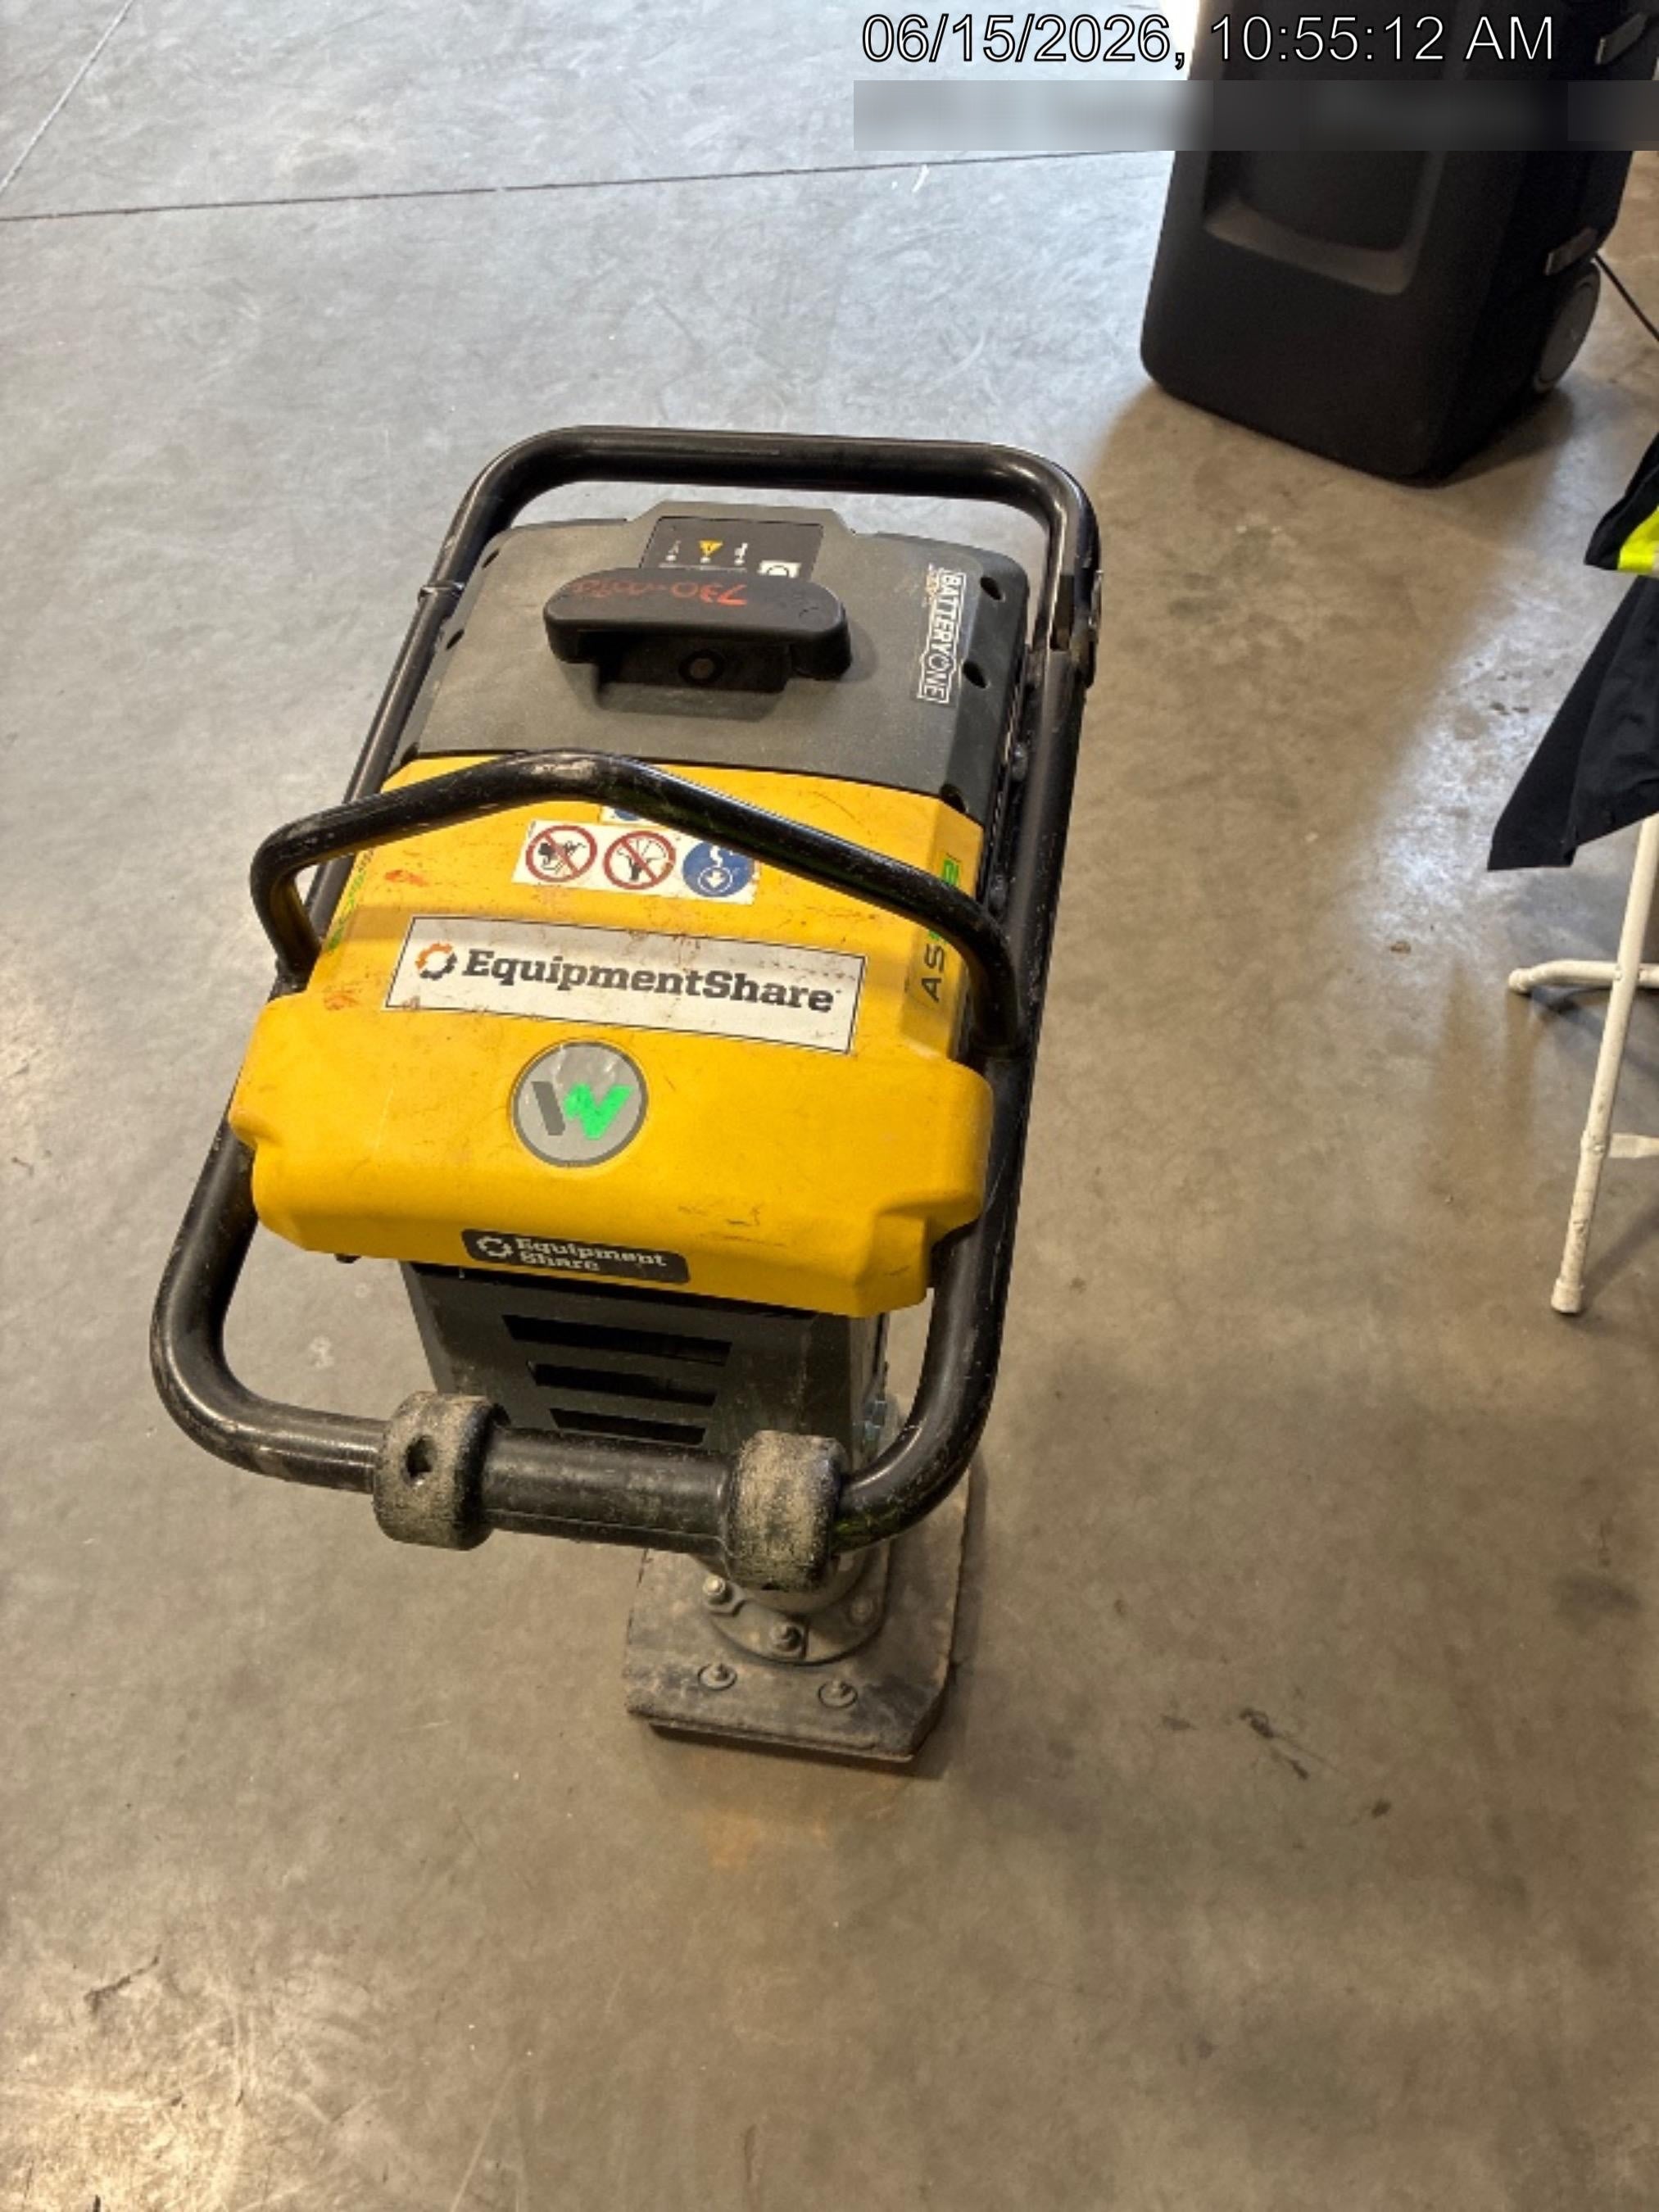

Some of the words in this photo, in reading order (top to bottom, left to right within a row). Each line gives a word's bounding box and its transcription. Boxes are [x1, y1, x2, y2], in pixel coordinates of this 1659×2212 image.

[461, 948, 833, 1013] EquipmentShare
[514, 1236, 668, 1267] Equipment
[519, 1251, 601, 1271] Share
